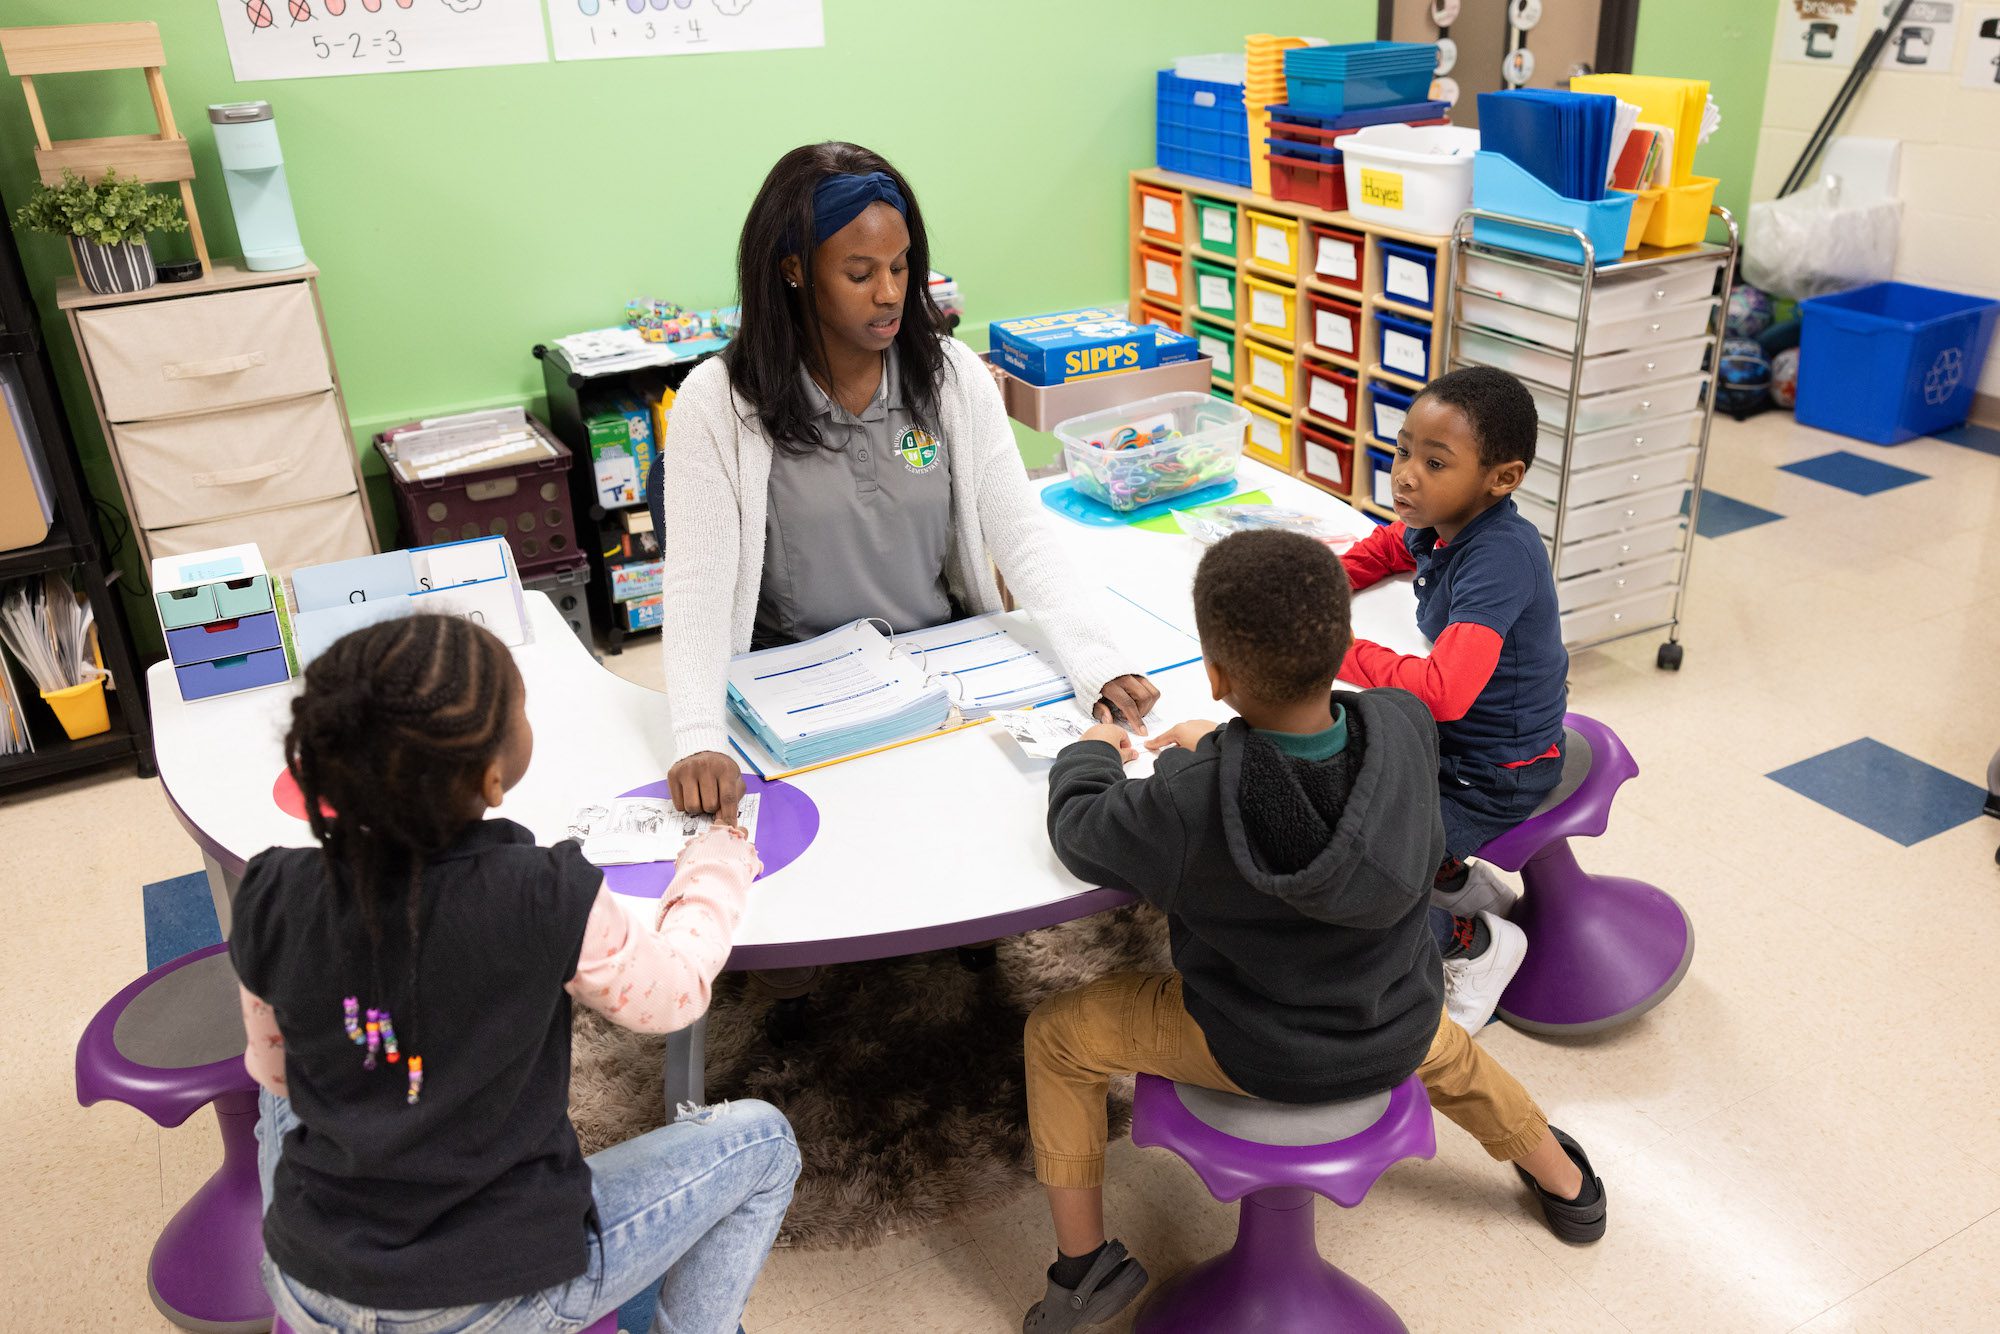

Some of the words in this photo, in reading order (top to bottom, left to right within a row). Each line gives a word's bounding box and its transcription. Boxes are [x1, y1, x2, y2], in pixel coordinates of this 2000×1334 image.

[644, 22, 656, 39] 3
[688, 19, 703, 38] 4
[1364, 177, 1399, 206] Hayes
[1065, 341, 1139, 374] SIPPS
